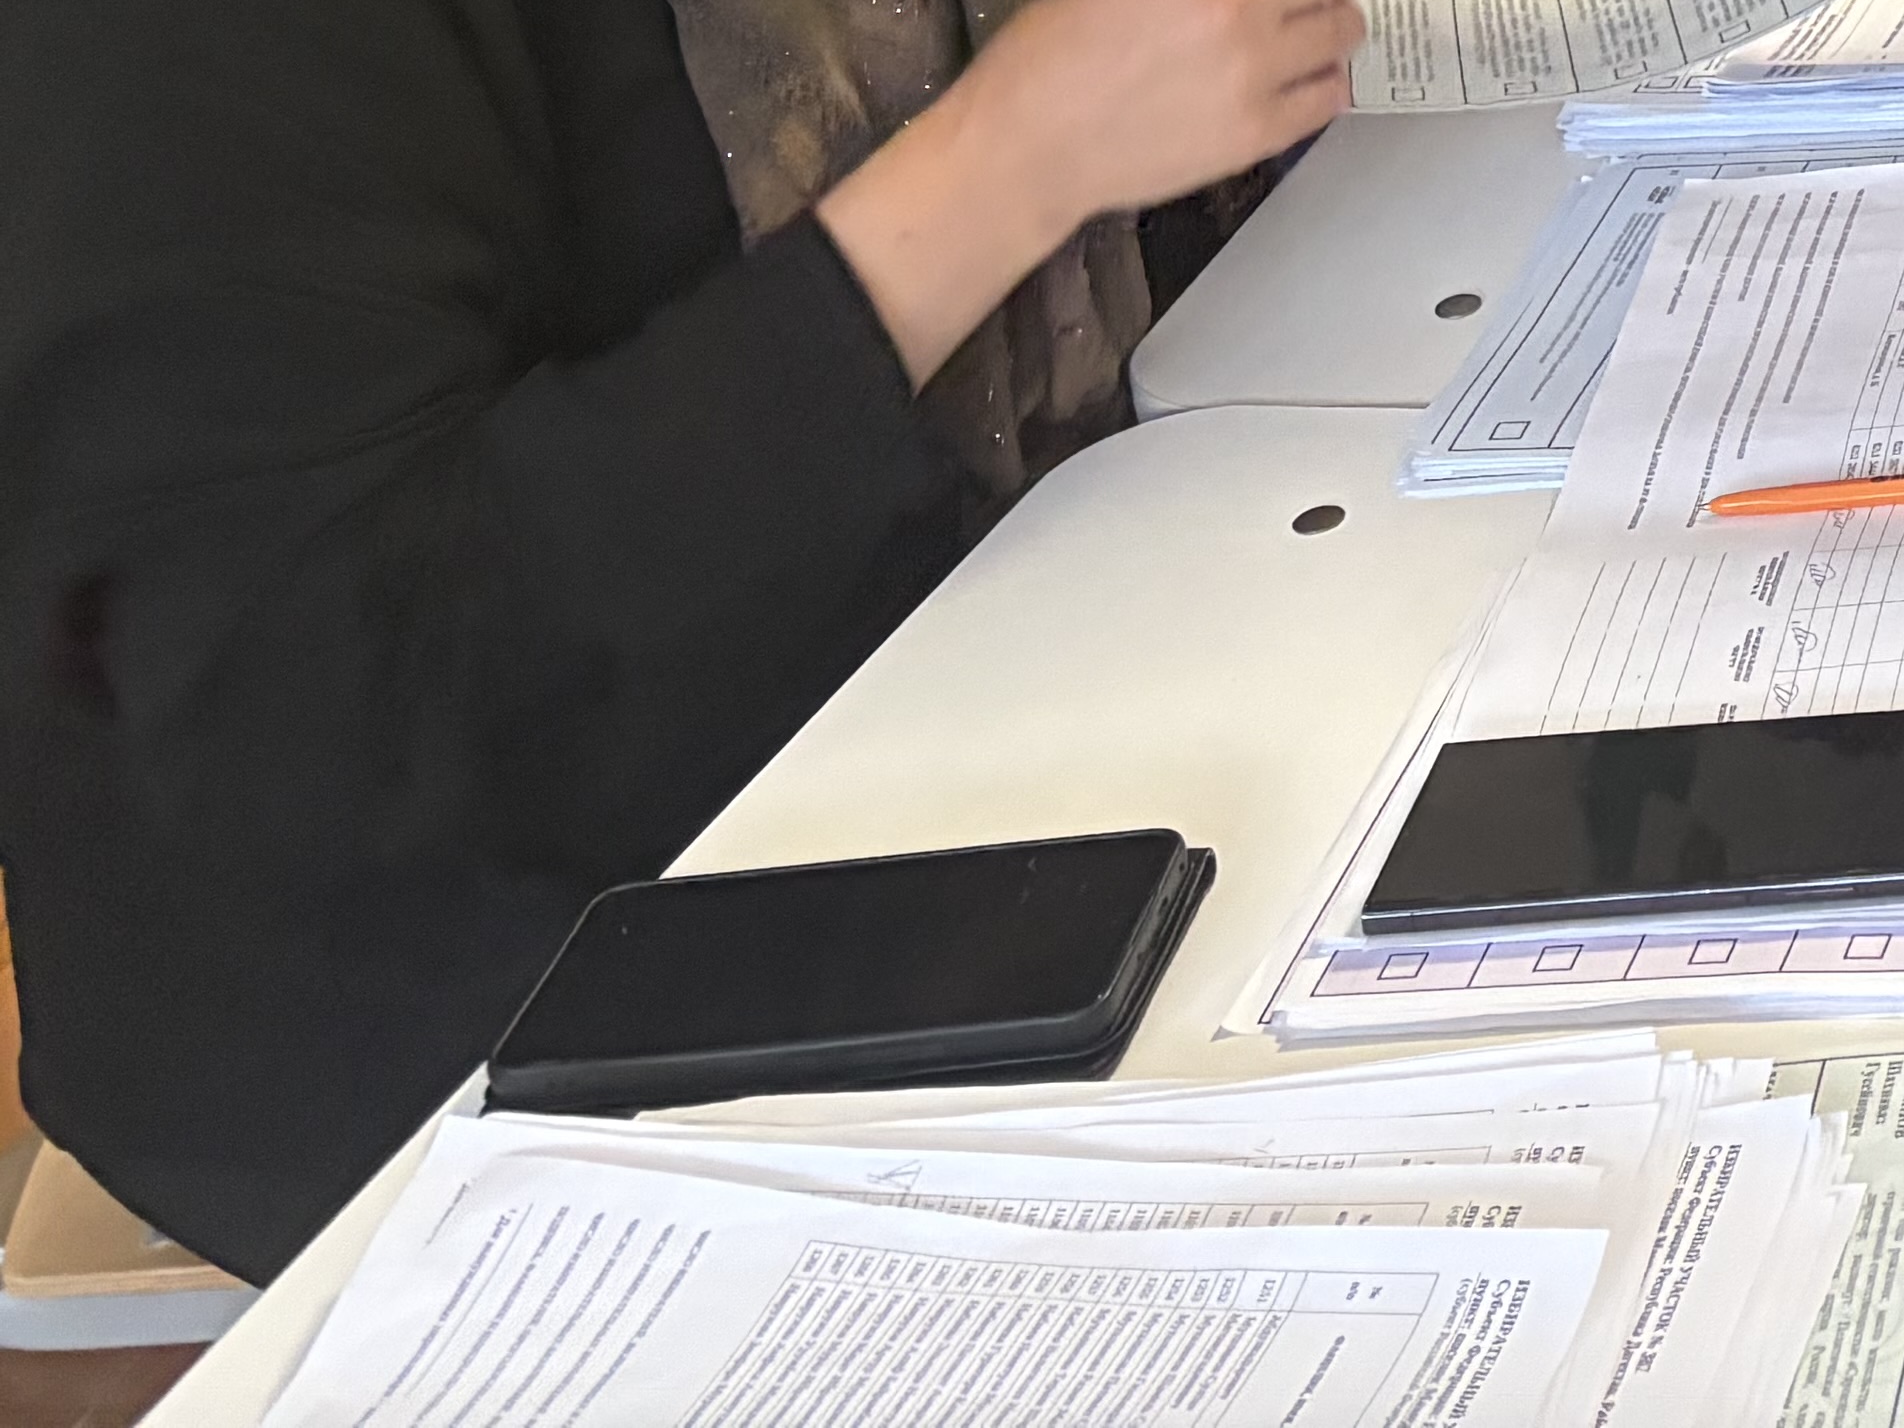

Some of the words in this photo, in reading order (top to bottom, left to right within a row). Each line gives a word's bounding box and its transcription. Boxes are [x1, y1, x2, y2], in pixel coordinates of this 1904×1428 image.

[1683, 1144, 1742, 1264] ИЗБИРАТЕЛЬНЫЙ
[1448, 1279, 1531, 1420] ИЗБИРАТЕЛЬНЫЙ
[1654, 1266, 1694, 1332] УЧАСТОК
